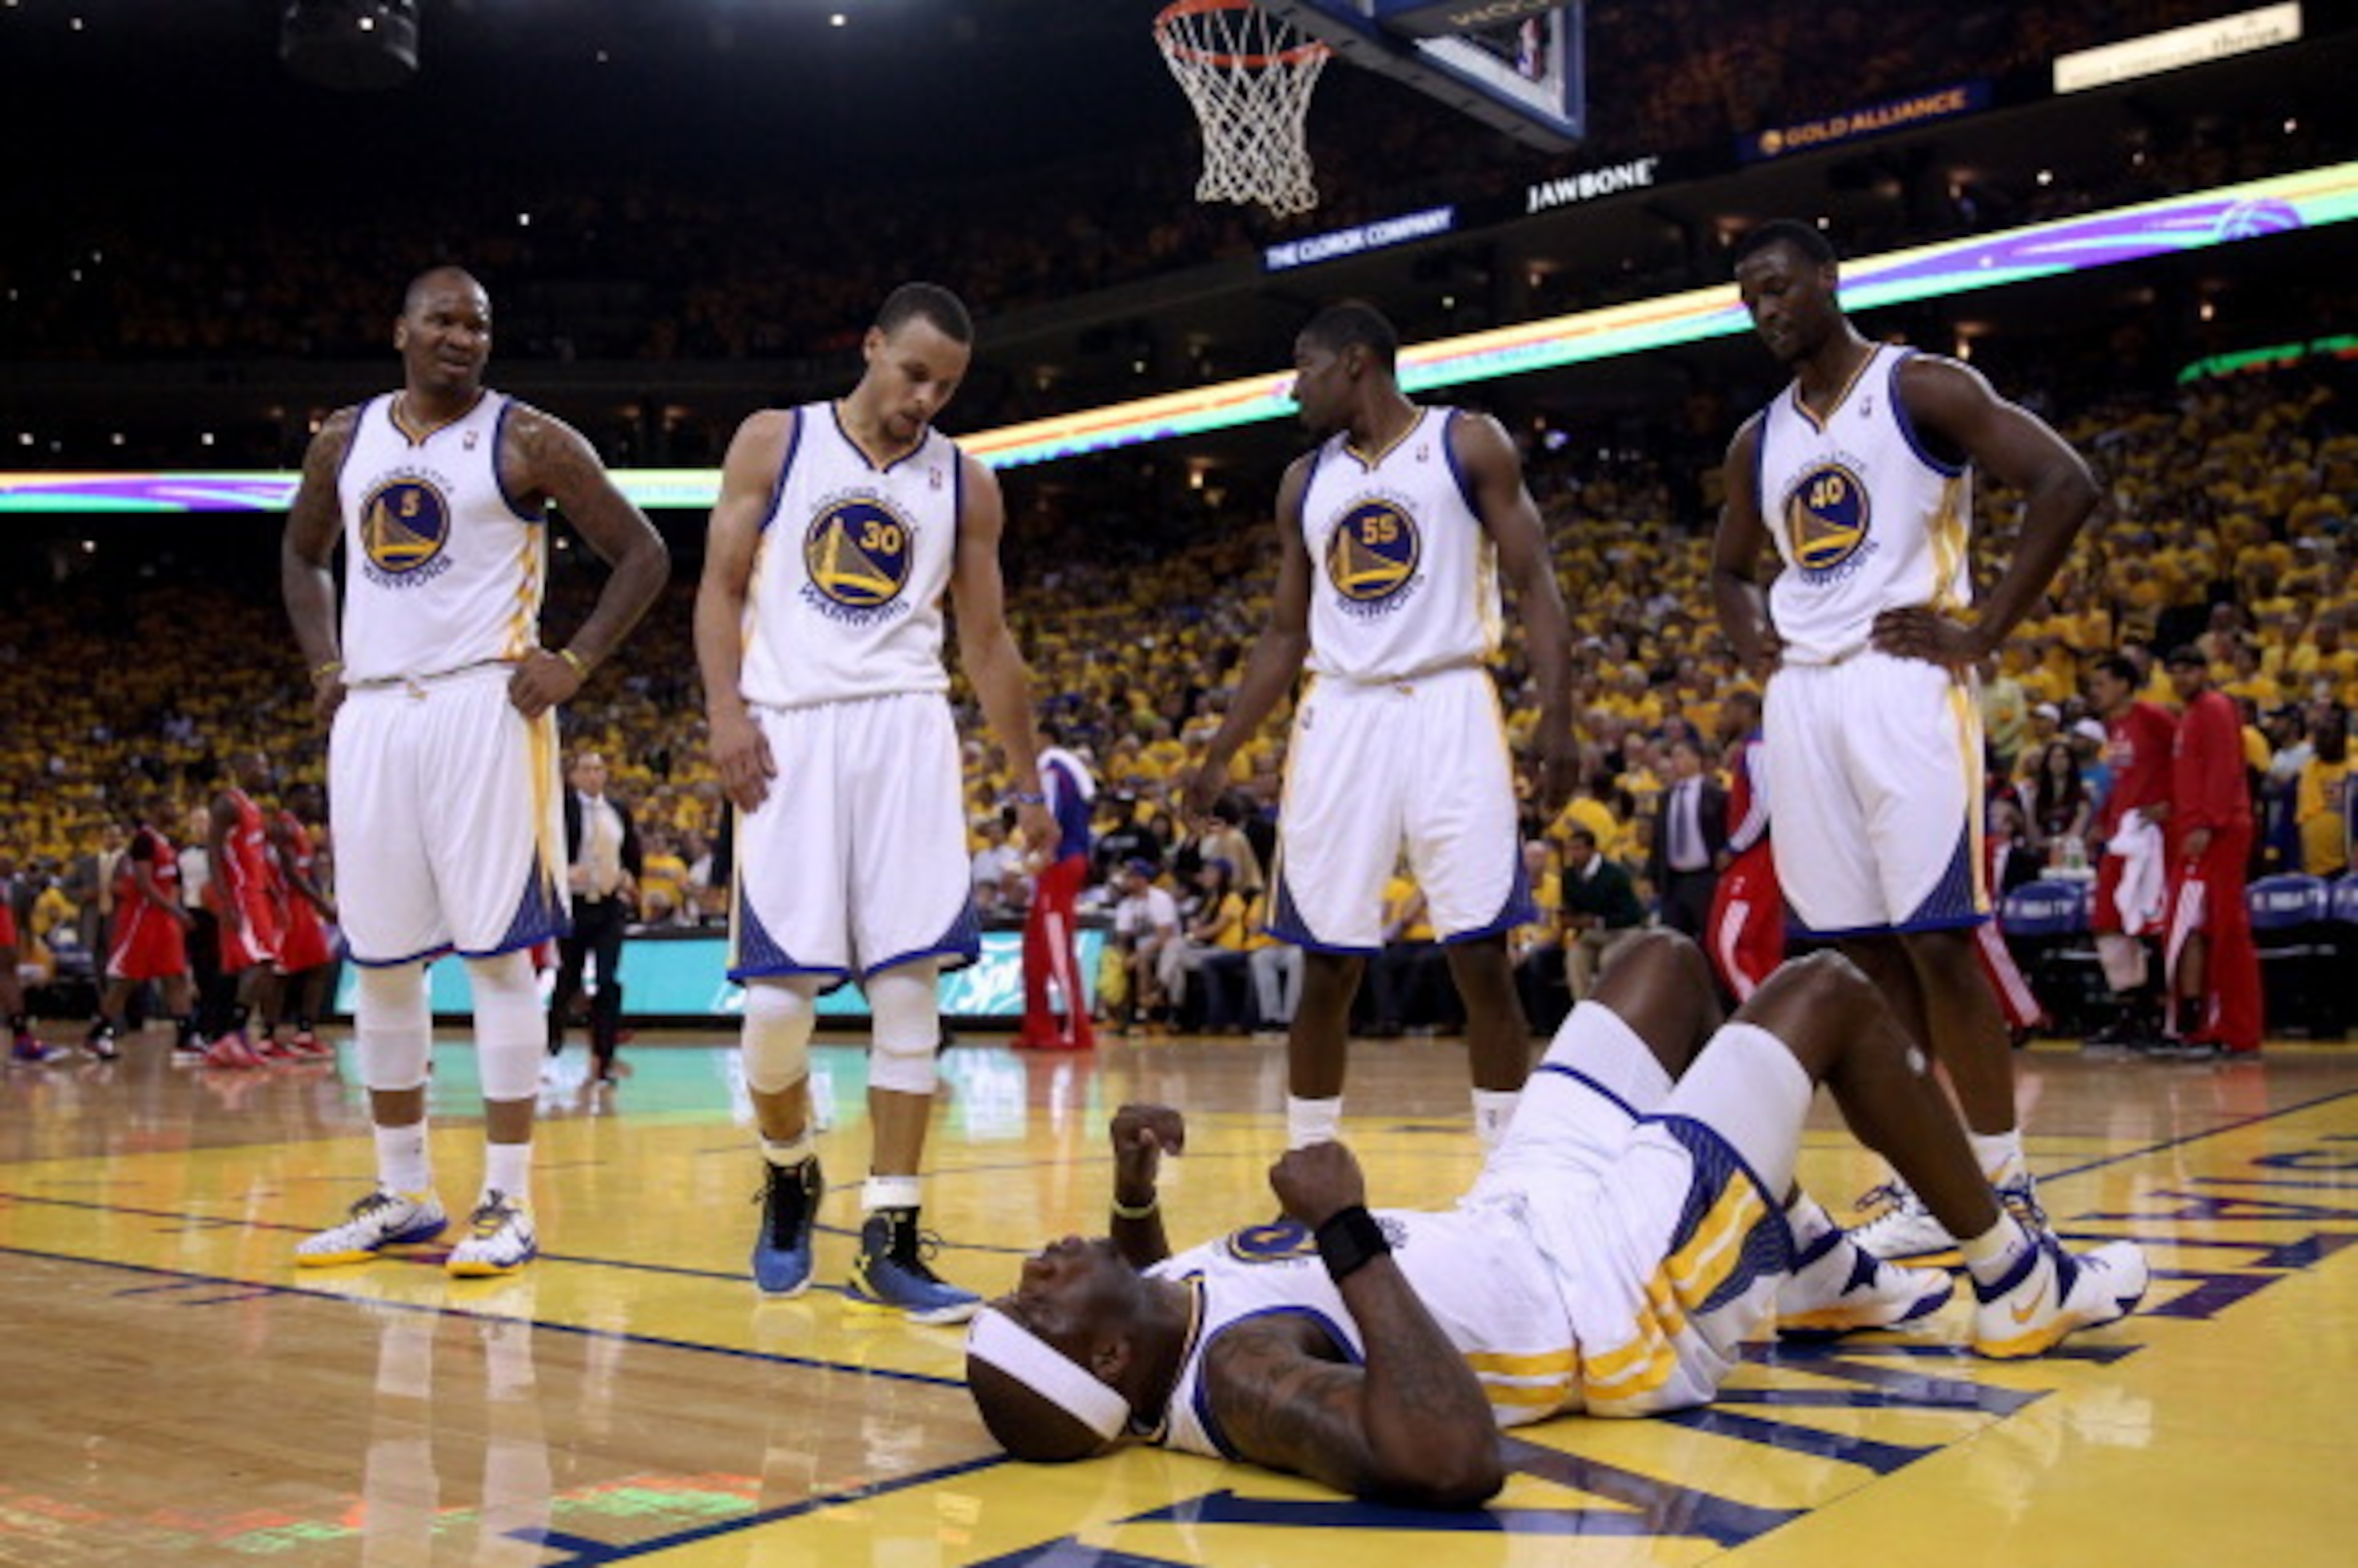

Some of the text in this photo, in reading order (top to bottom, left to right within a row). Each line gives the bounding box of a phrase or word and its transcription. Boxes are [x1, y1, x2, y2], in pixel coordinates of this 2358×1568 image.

[1785, 90, 1965, 147] GOLD ALLIANCE
[1525, 157, 1657, 214] JAWBONE
[400, 491, 421, 518] 5
[1810, 476, 1846, 510] 40
[860, 521, 901, 556] 30
[1361, 513, 1399, 546] 55
